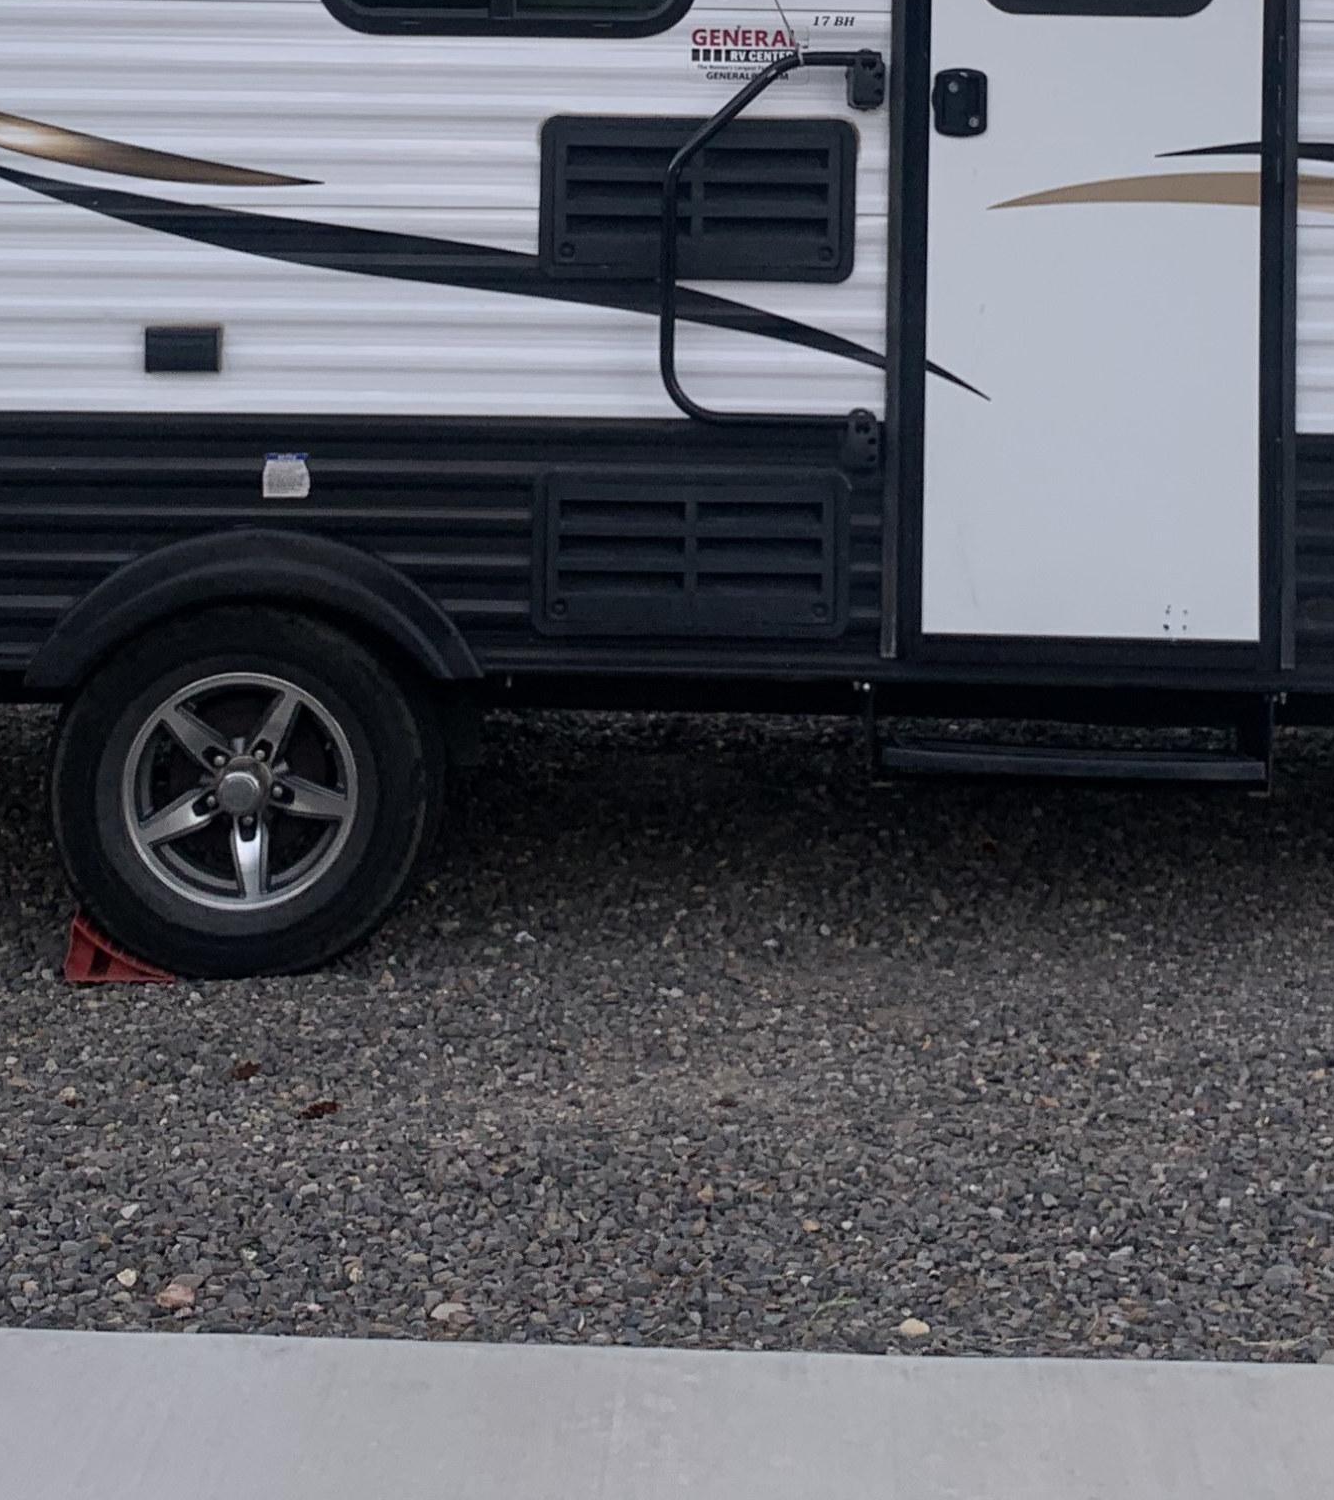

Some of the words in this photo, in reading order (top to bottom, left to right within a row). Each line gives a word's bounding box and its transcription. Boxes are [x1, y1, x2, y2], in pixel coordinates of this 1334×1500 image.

[813, 16, 831, 26] 17
[834, 16, 855, 26] BH
[692, 29, 795, 47] GENERAL
[730, 51, 747, 61] RV
